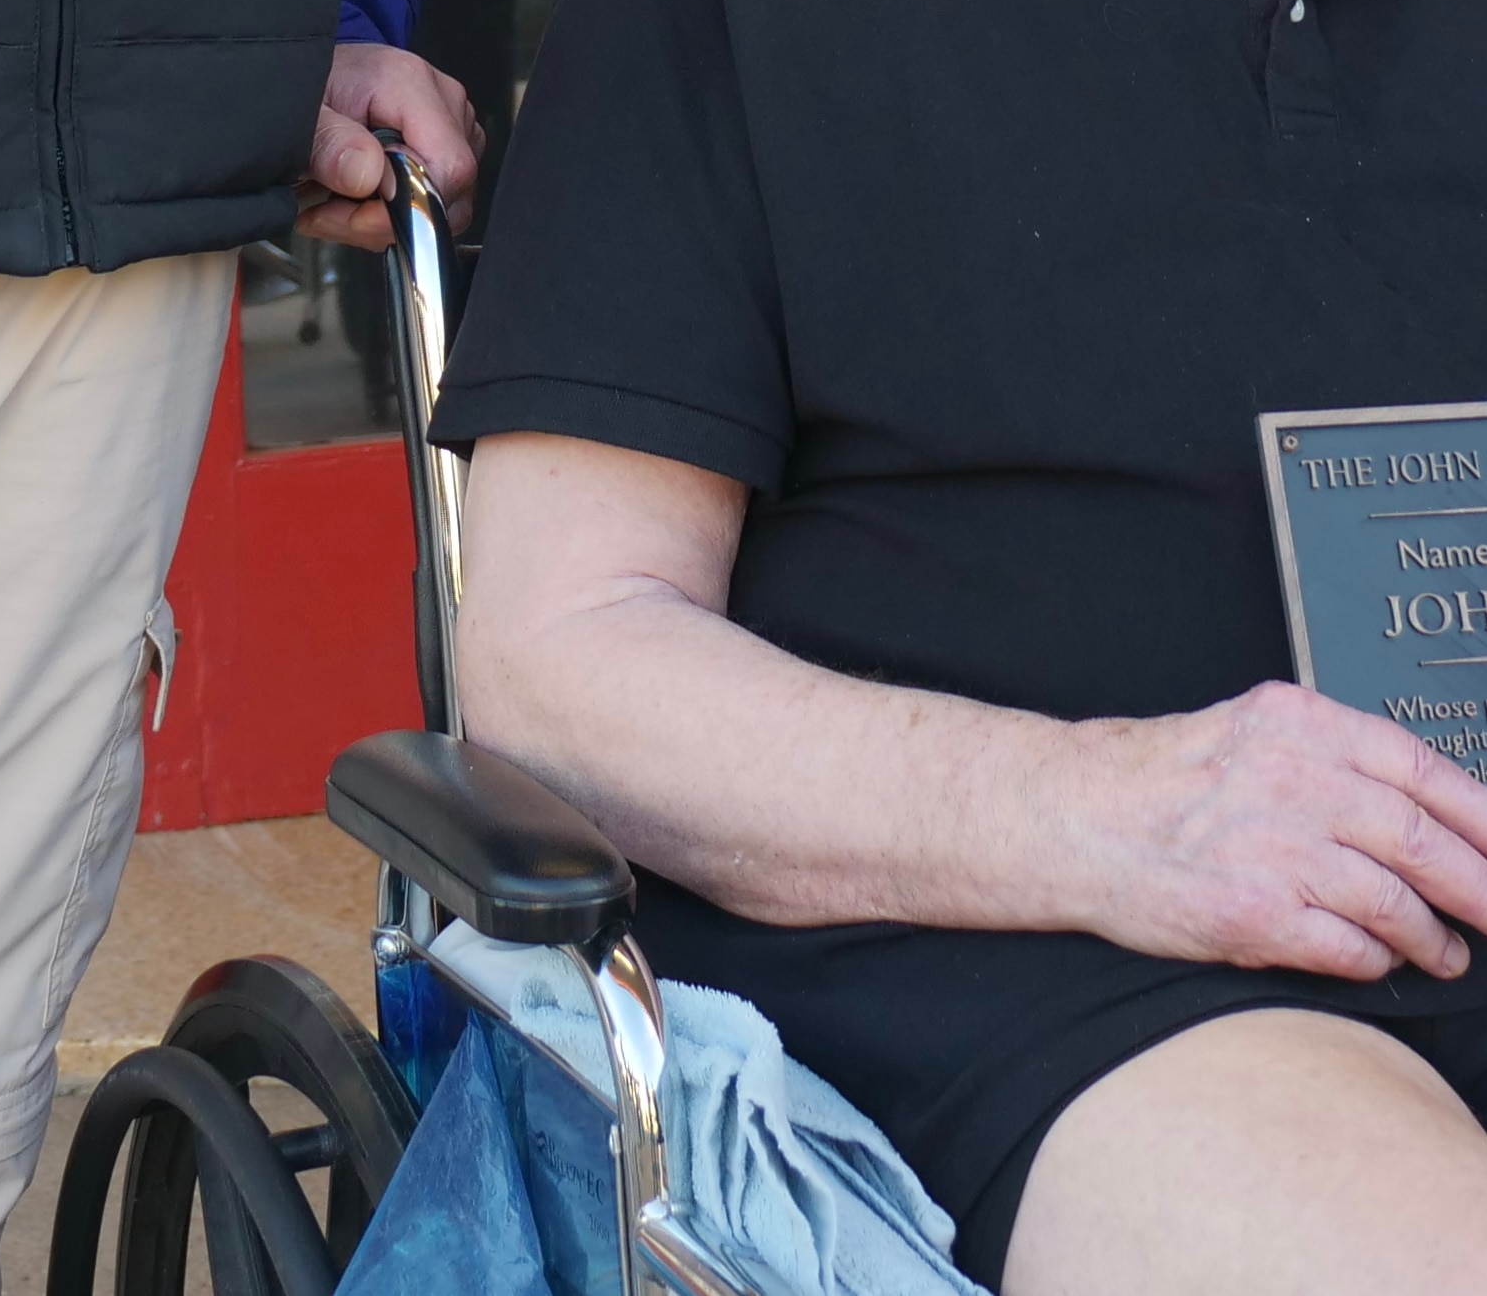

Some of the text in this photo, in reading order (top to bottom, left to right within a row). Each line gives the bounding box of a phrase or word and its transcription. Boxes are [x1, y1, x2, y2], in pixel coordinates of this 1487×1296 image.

[1301, 456, 1376, 490] THE
[1386, 451, 1481, 485] JOHN
[1384, 696, 1478, 723] Whose
